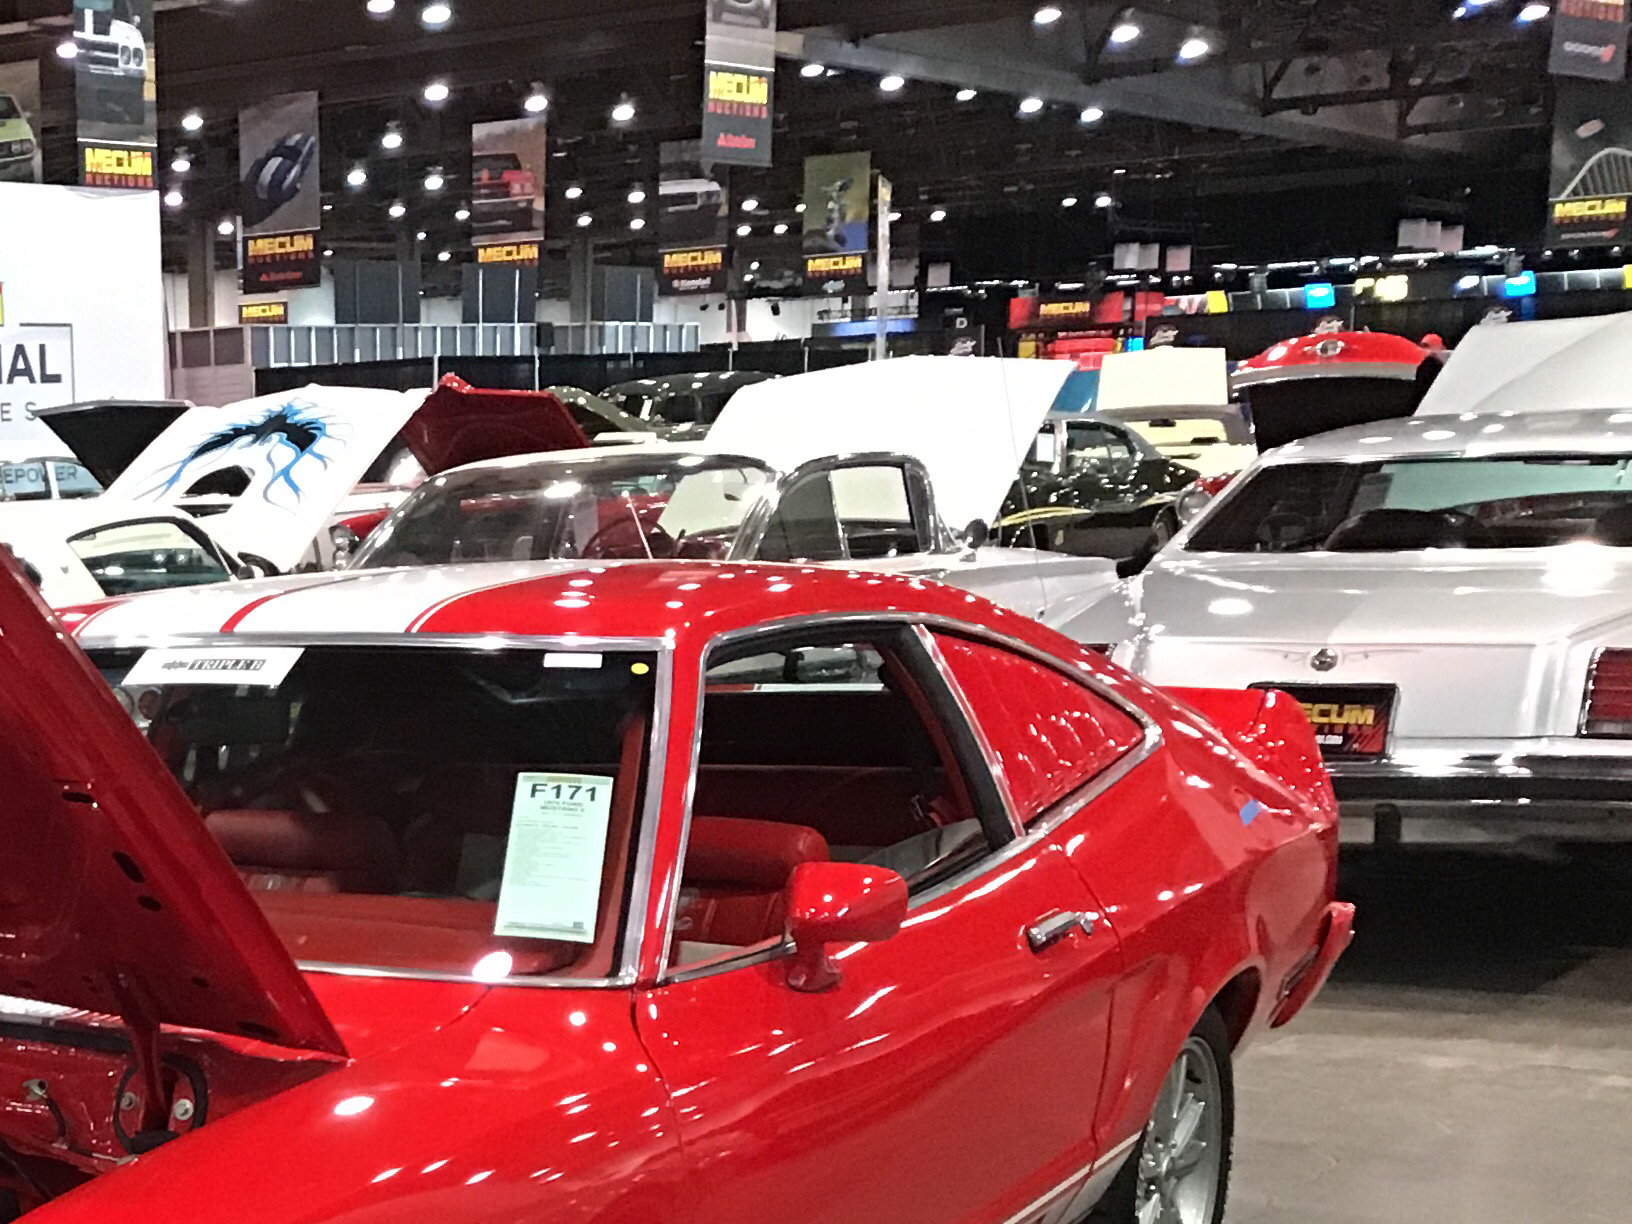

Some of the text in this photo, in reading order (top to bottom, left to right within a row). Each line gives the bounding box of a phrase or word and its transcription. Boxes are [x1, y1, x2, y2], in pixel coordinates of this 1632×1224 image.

[709, 70, 768, 105] MECUM
[85, 148, 152, 175] MECUM
[248, 233, 314, 257] MECUM
[478, 243, 539, 263] MECUM
[664, 250, 722, 268] MECUM
[808, 254, 863, 272] MECUM
[1300, 702, 1375, 725] ECUM
[530, 783, 597, 802] F171
